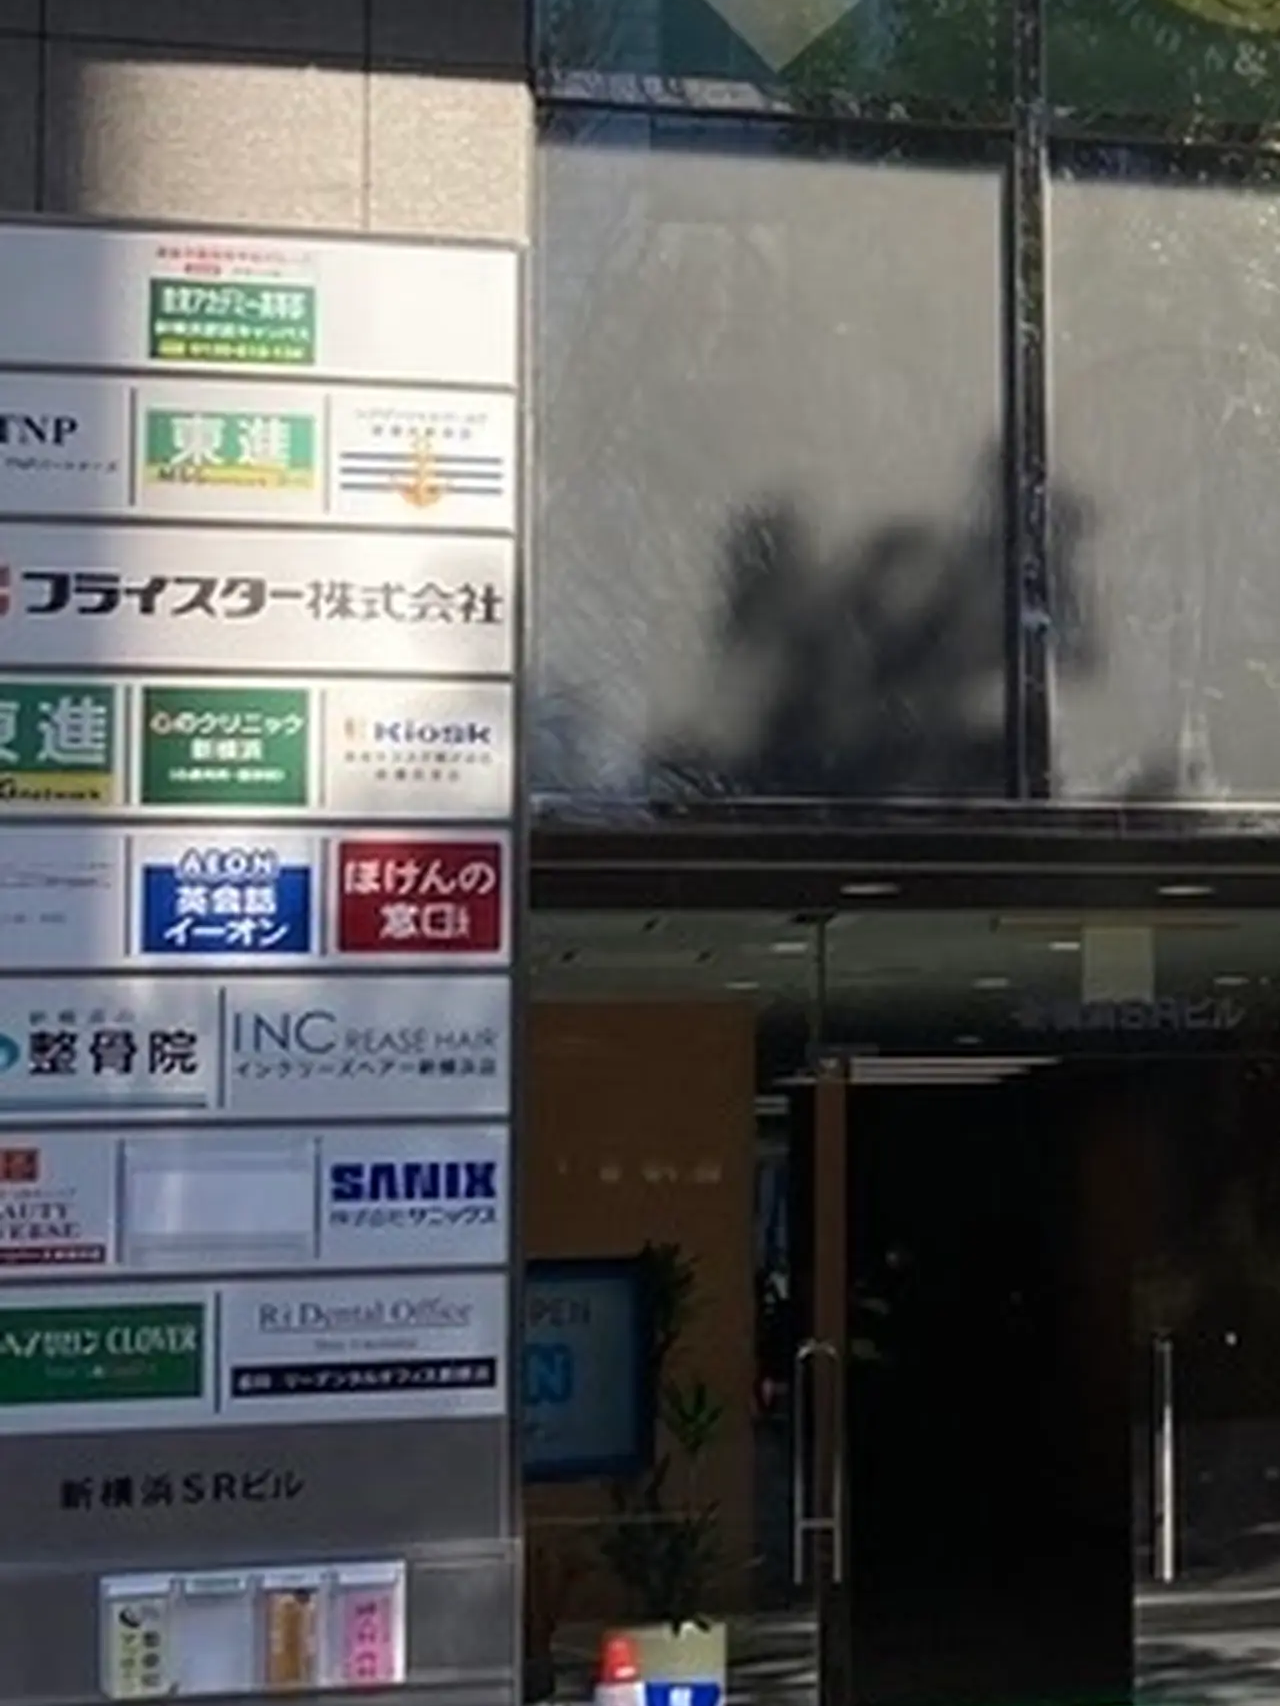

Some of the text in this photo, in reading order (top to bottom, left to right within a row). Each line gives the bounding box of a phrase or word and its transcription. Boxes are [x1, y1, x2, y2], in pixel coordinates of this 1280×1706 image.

[170, 413, 292, 466] 東進
[151, 712, 303, 736] 心のクリニック
[375, 718, 492, 746] Kiosk
[346, 859, 496, 894] ほけんの
[177, 887, 277, 914] 英会話
[165, 918, 289, 947] イーオン
[30, 1031, 198, 1076] 整骨院
[331, 1162, 498, 1202] SANIX
[301, 1301, 385, 1327] Dental
[390, 1296, 474, 1324] Office
[61, 1470, 304, 1511] 新横浜SRビル
